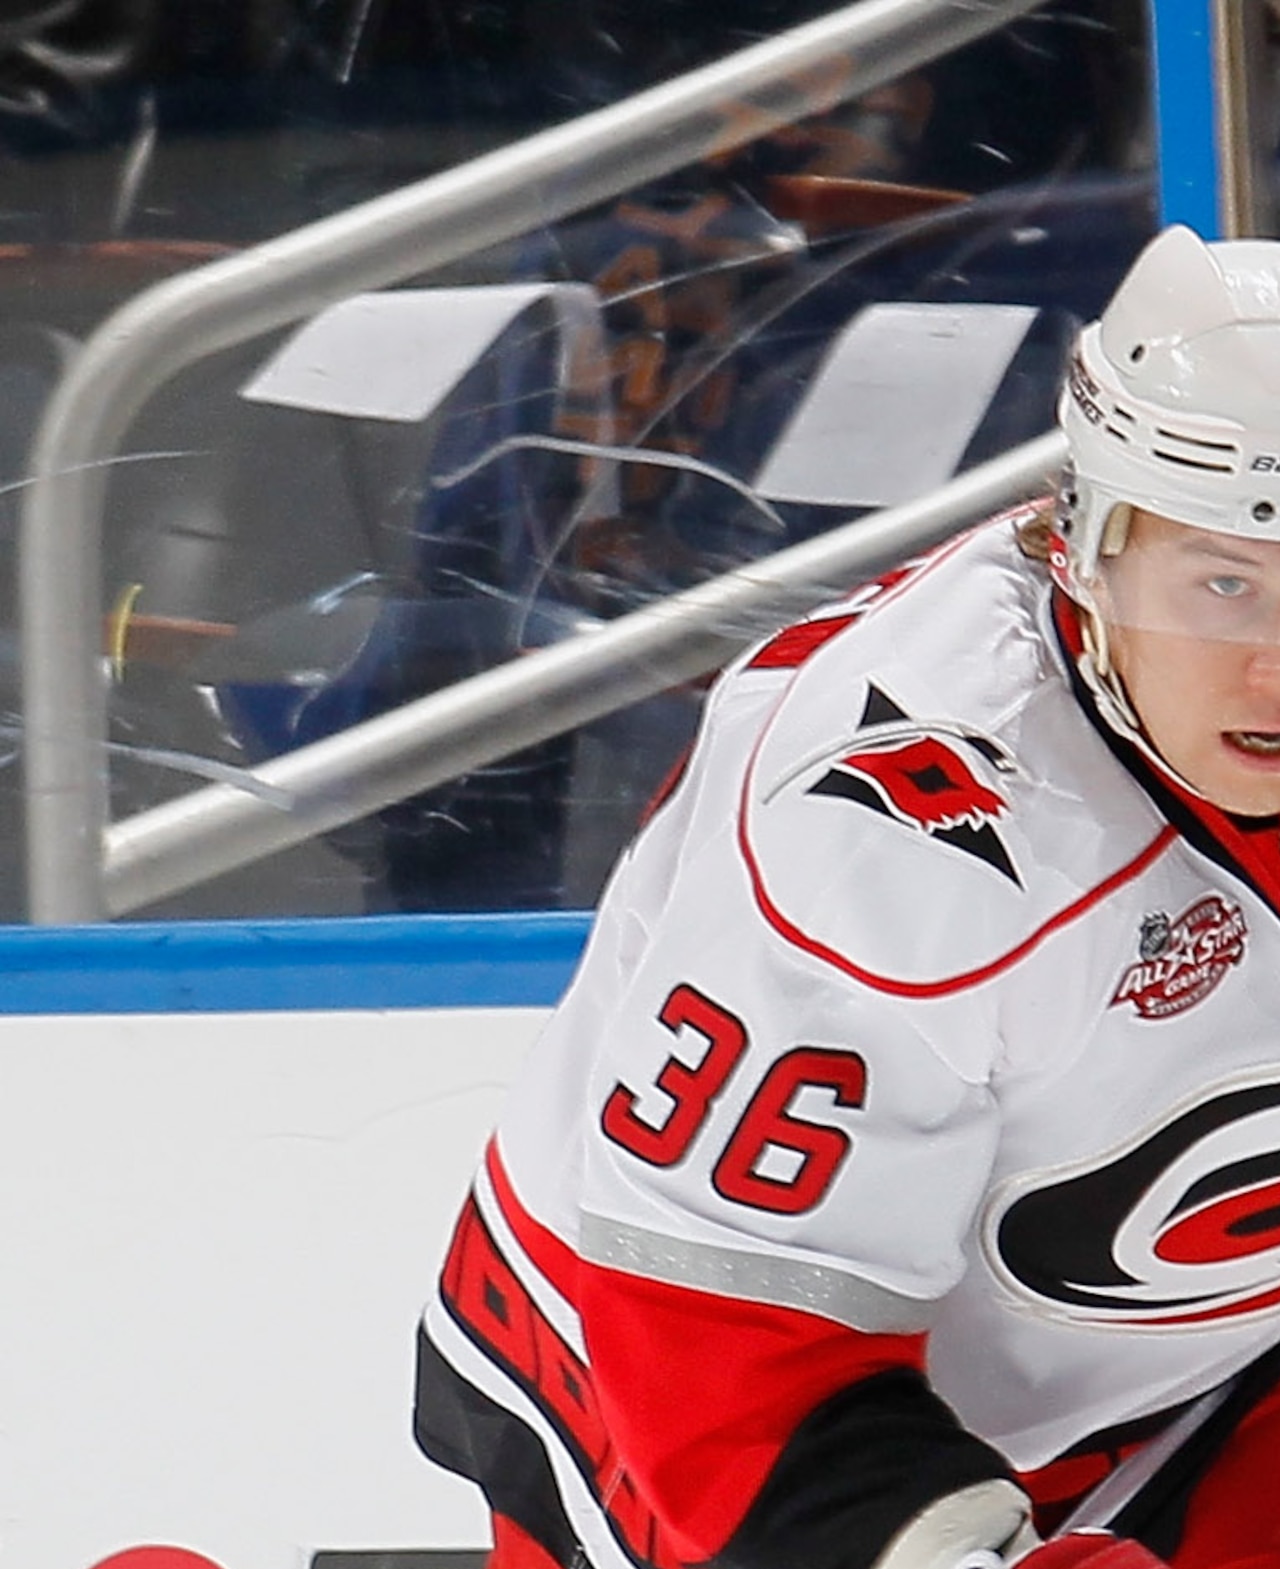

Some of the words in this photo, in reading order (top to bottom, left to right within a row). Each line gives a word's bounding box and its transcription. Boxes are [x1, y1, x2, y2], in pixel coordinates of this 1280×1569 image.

[1117, 961, 1167, 999] ALL
[1197, 911, 1248, 965] STAR
[600, 981, 868, 1217] 36
